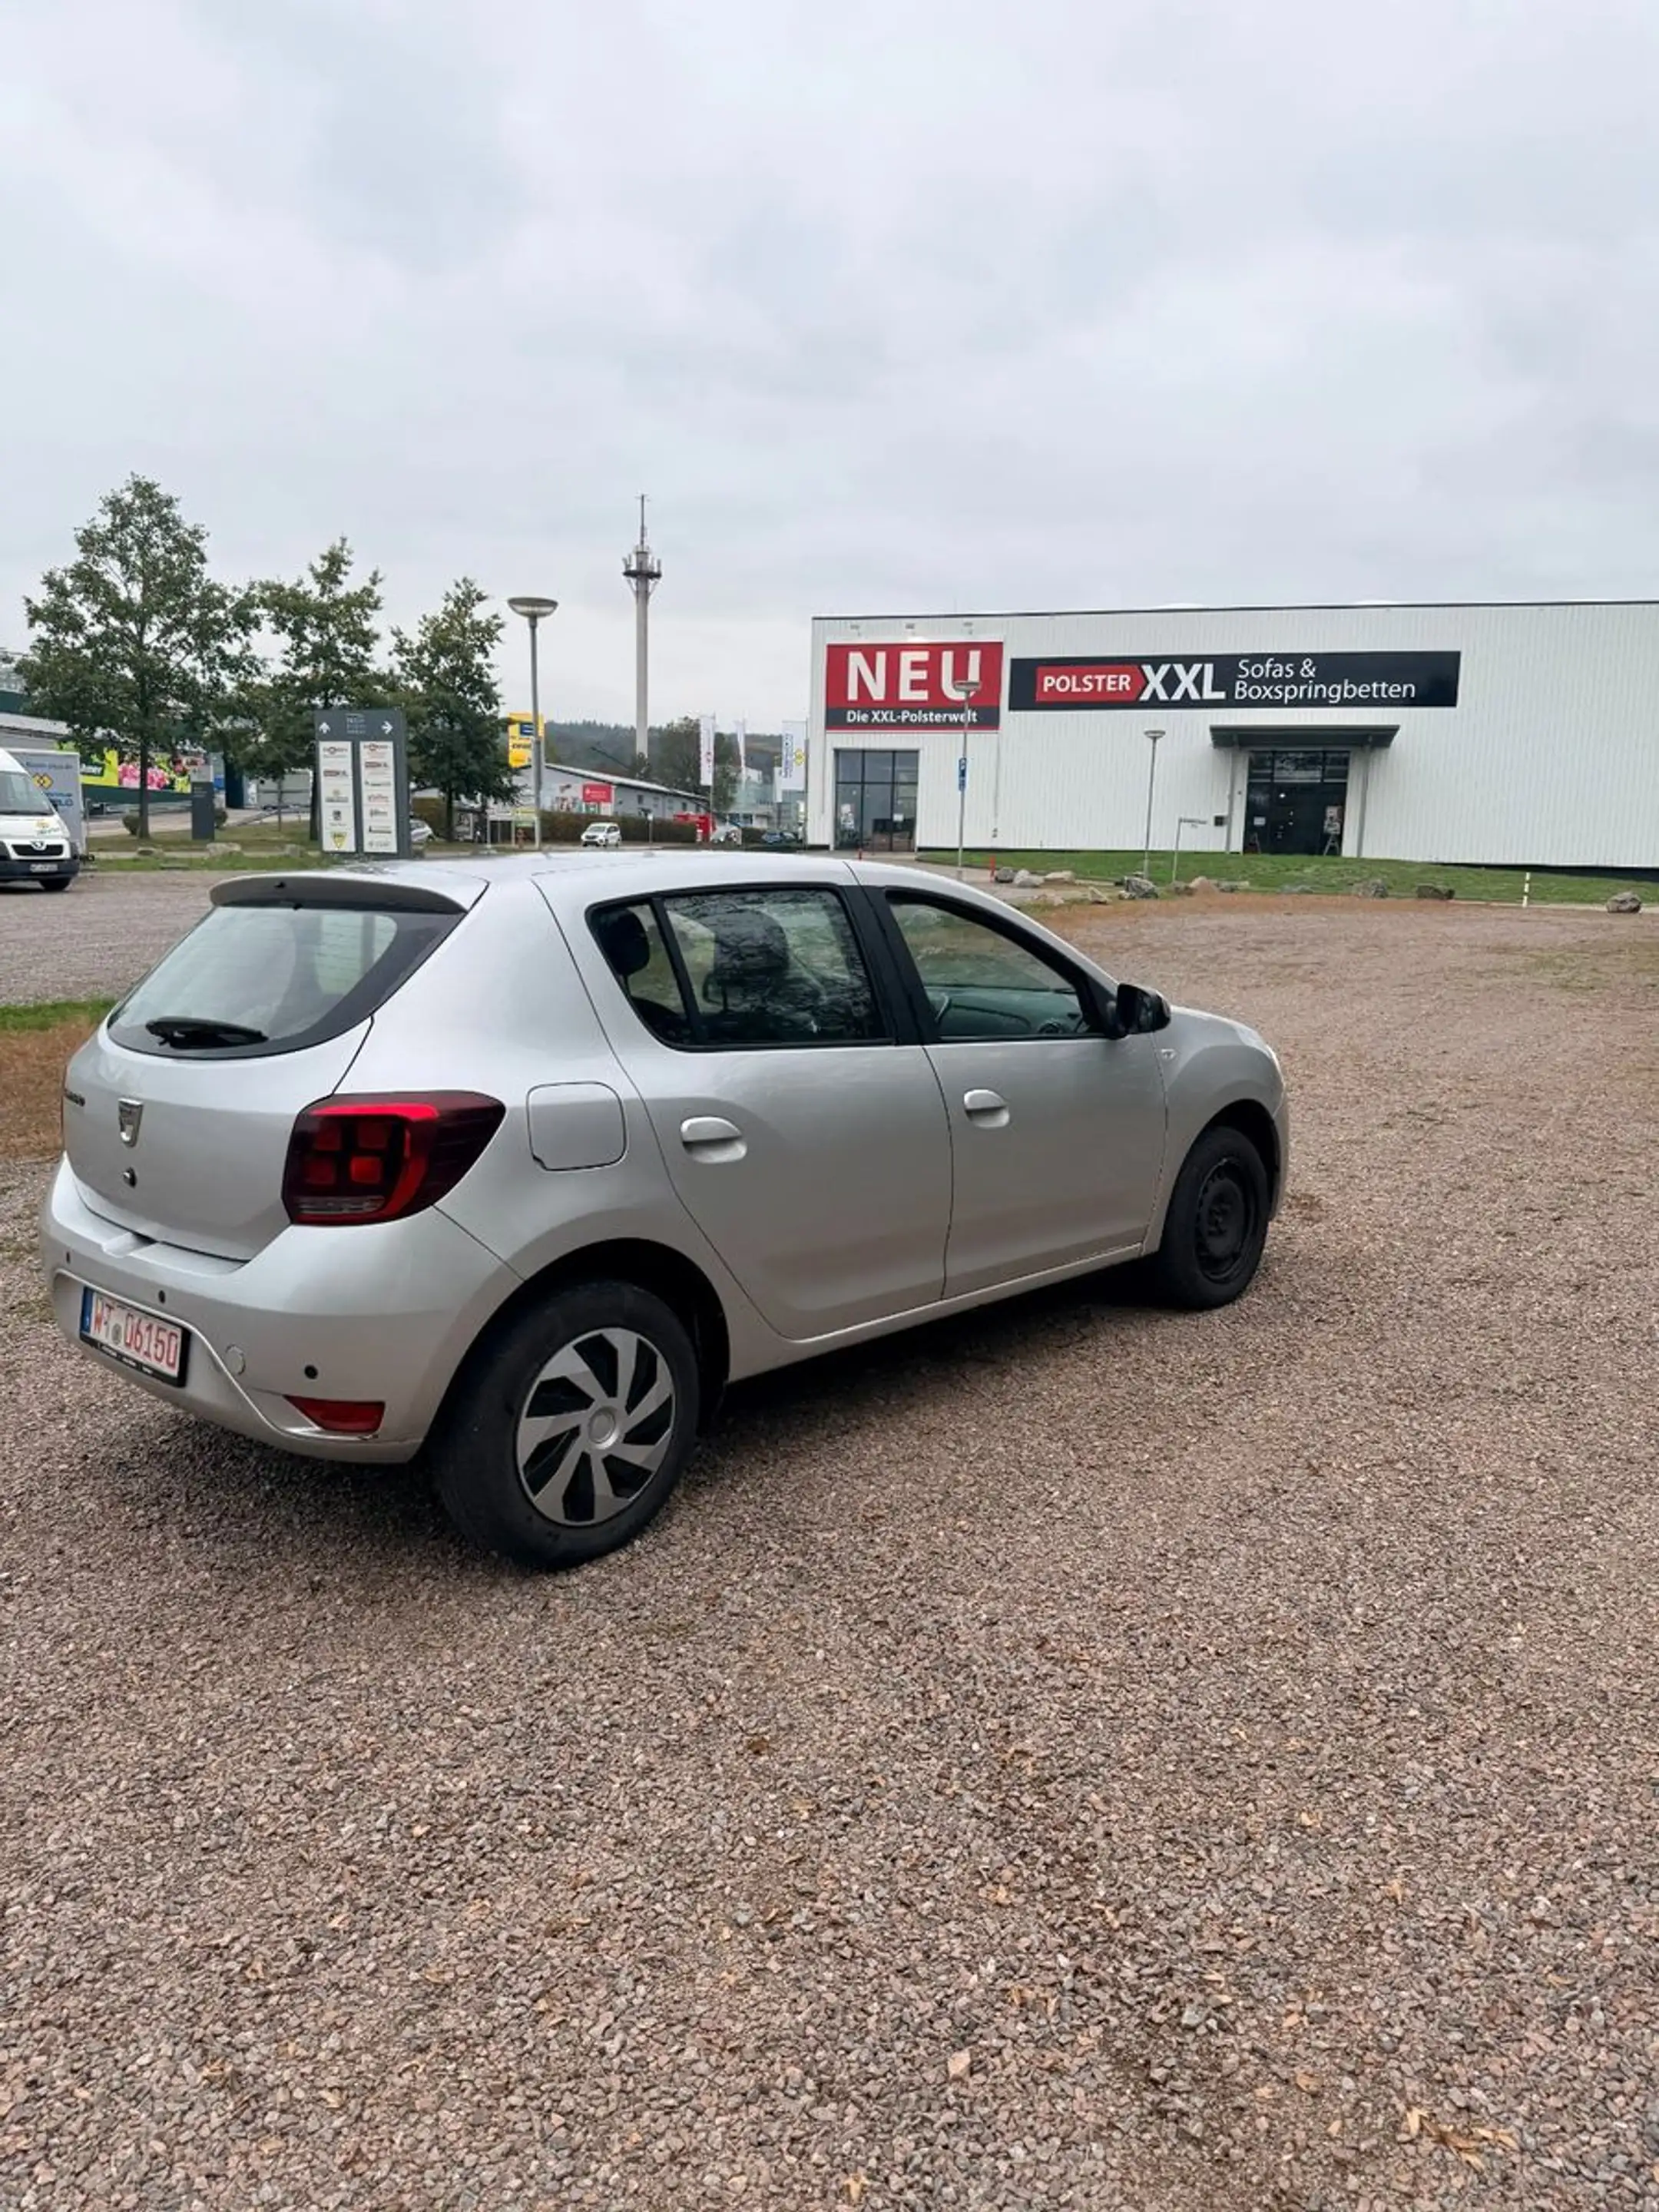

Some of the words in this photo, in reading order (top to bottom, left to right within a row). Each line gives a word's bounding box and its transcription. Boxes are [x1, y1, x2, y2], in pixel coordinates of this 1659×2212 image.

[846, 650, 982, 700] NEU
[1042, 674, 1132, 694] POLSTER
[1138, 663, 1227, 702] XXL
[1237, 658, 1295, 679] Sofas
[1299, 657, 1317, 678] &
[1233, 678, 1416, 705] Boxspringbetten
[846, 709, 869, 724] Die
[871, 708, 979, 724] XXL-Polsterwelt
[124, 1312, 178, 1369] 06150
